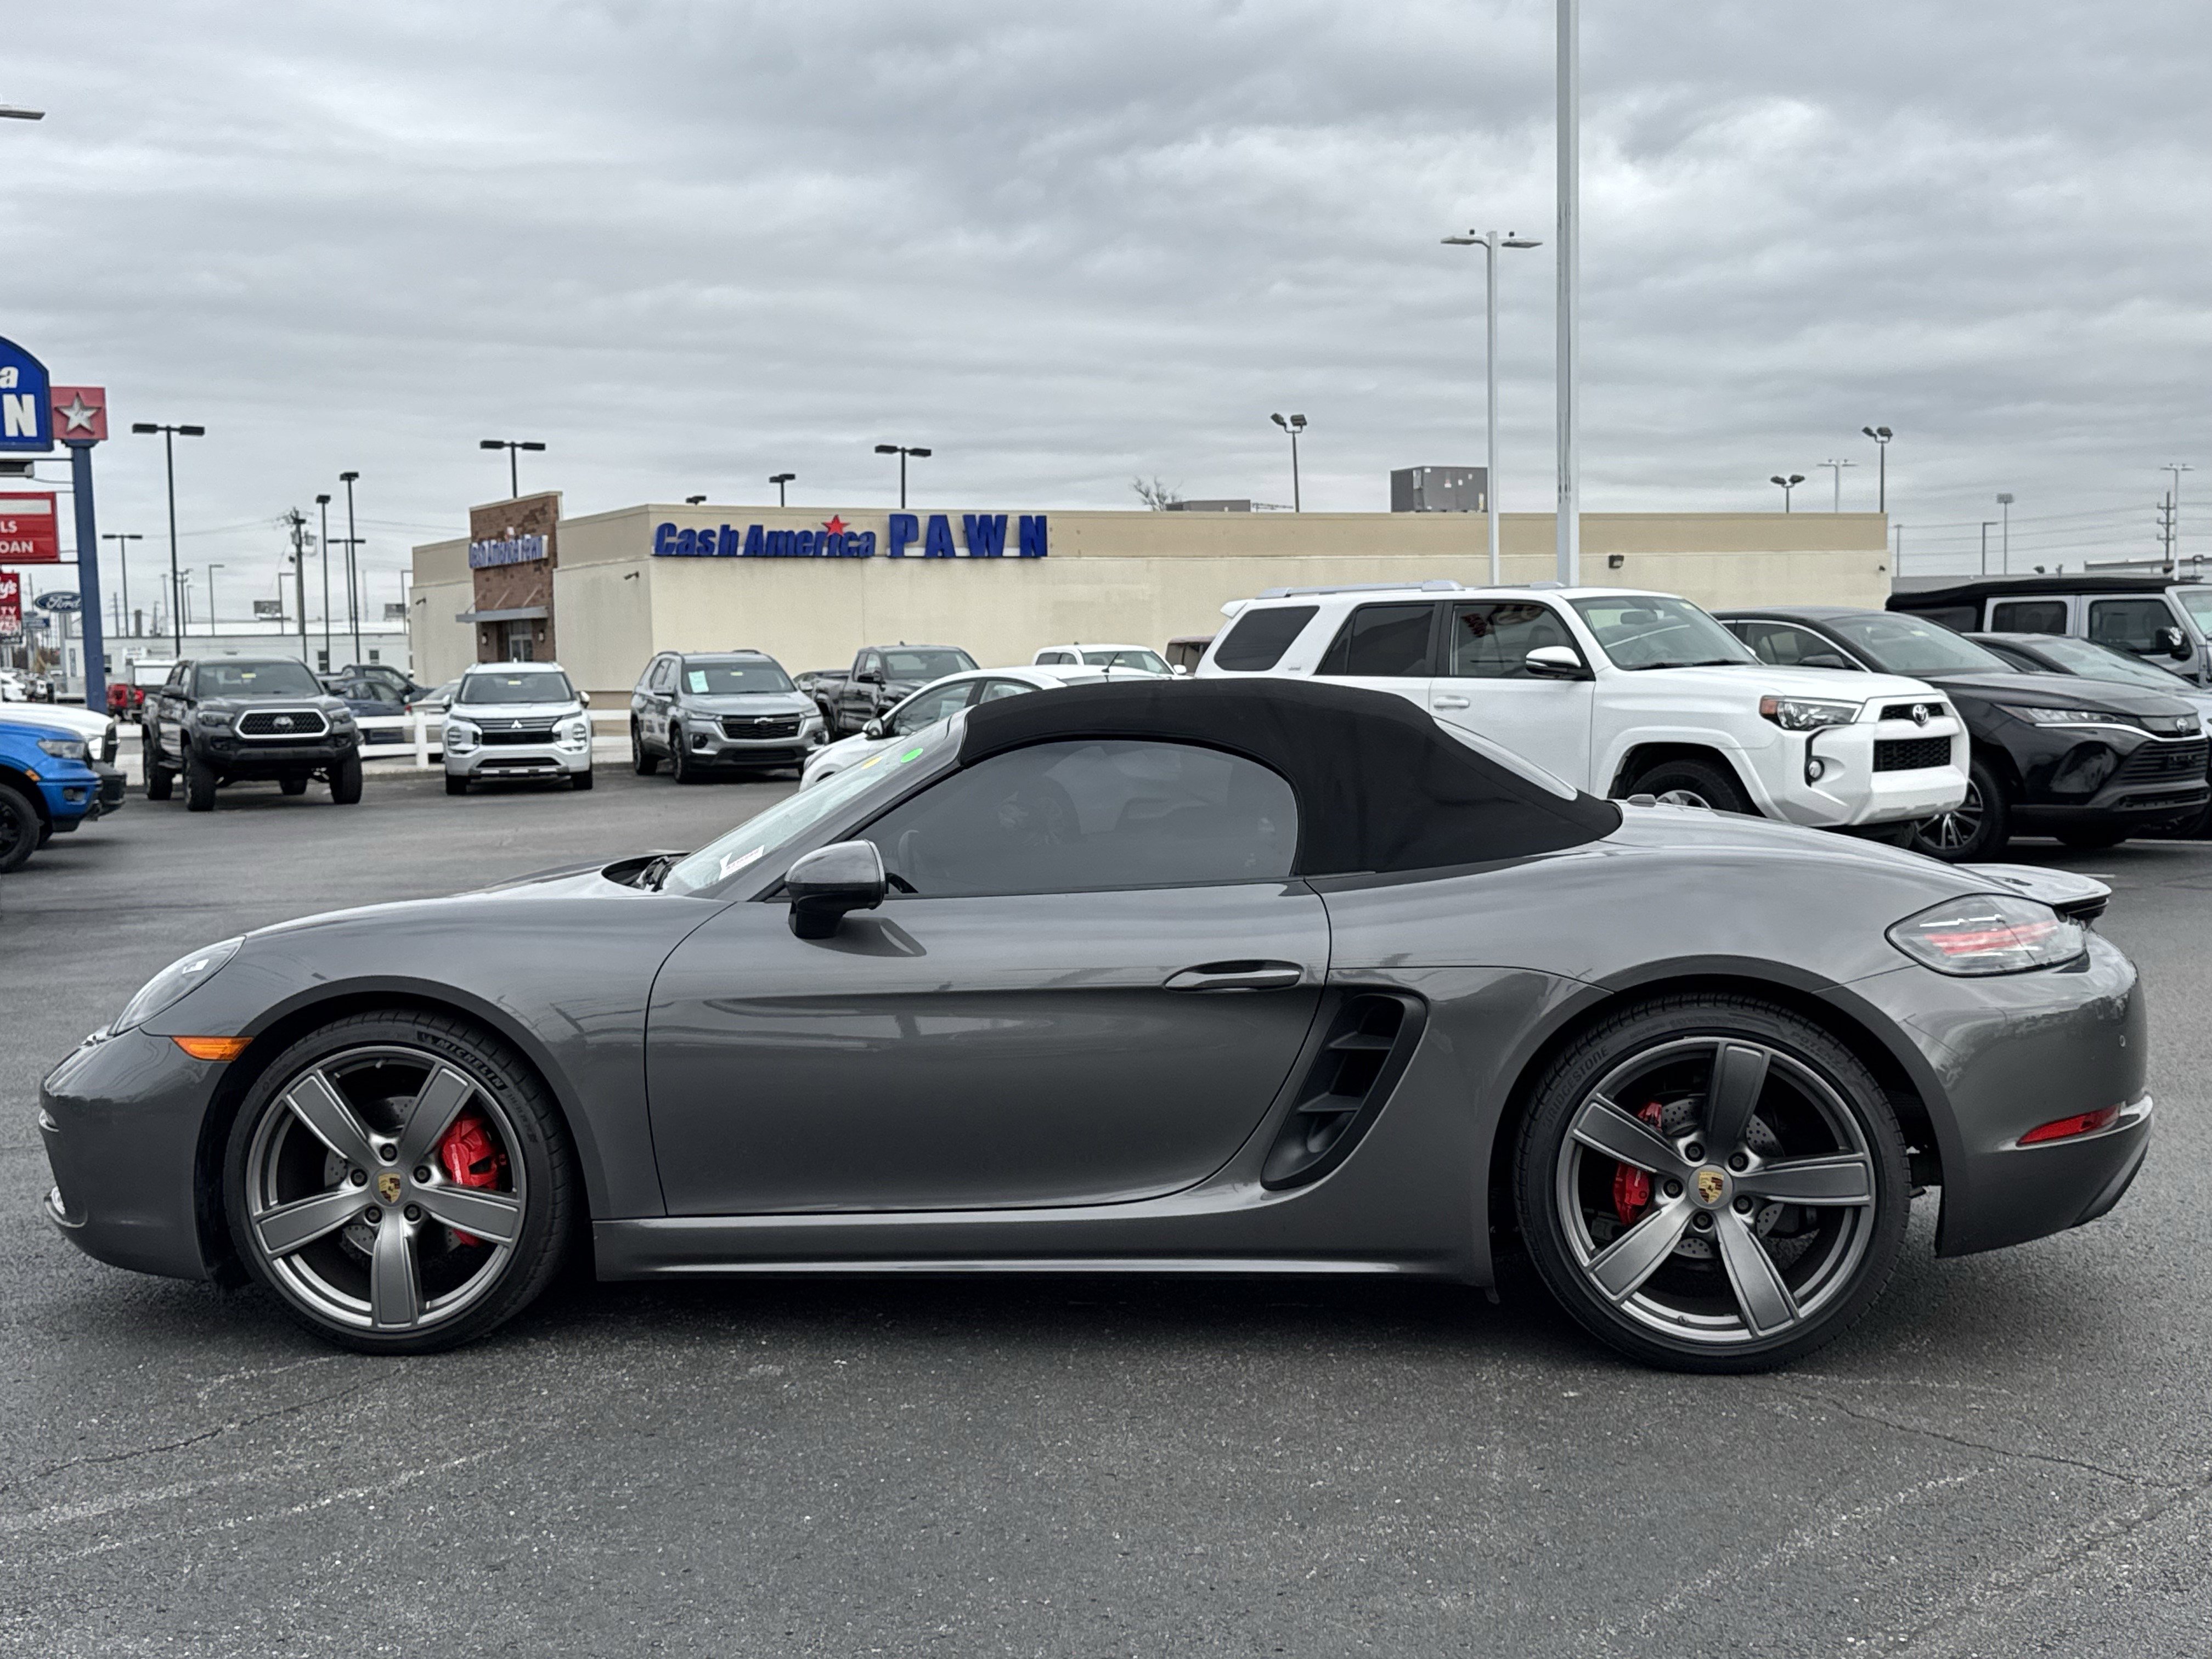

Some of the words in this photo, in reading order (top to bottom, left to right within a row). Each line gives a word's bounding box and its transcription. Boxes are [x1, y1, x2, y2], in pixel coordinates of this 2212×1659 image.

[655, 522, 739, 556] Cash
[743, 524, 876, 557] America
[888, 514, 1047, 557] PAWN
[437, 1041, 504, 1088] MICHELIN
[1542, 1045, 1610, 1128] BRIDGESTONE
